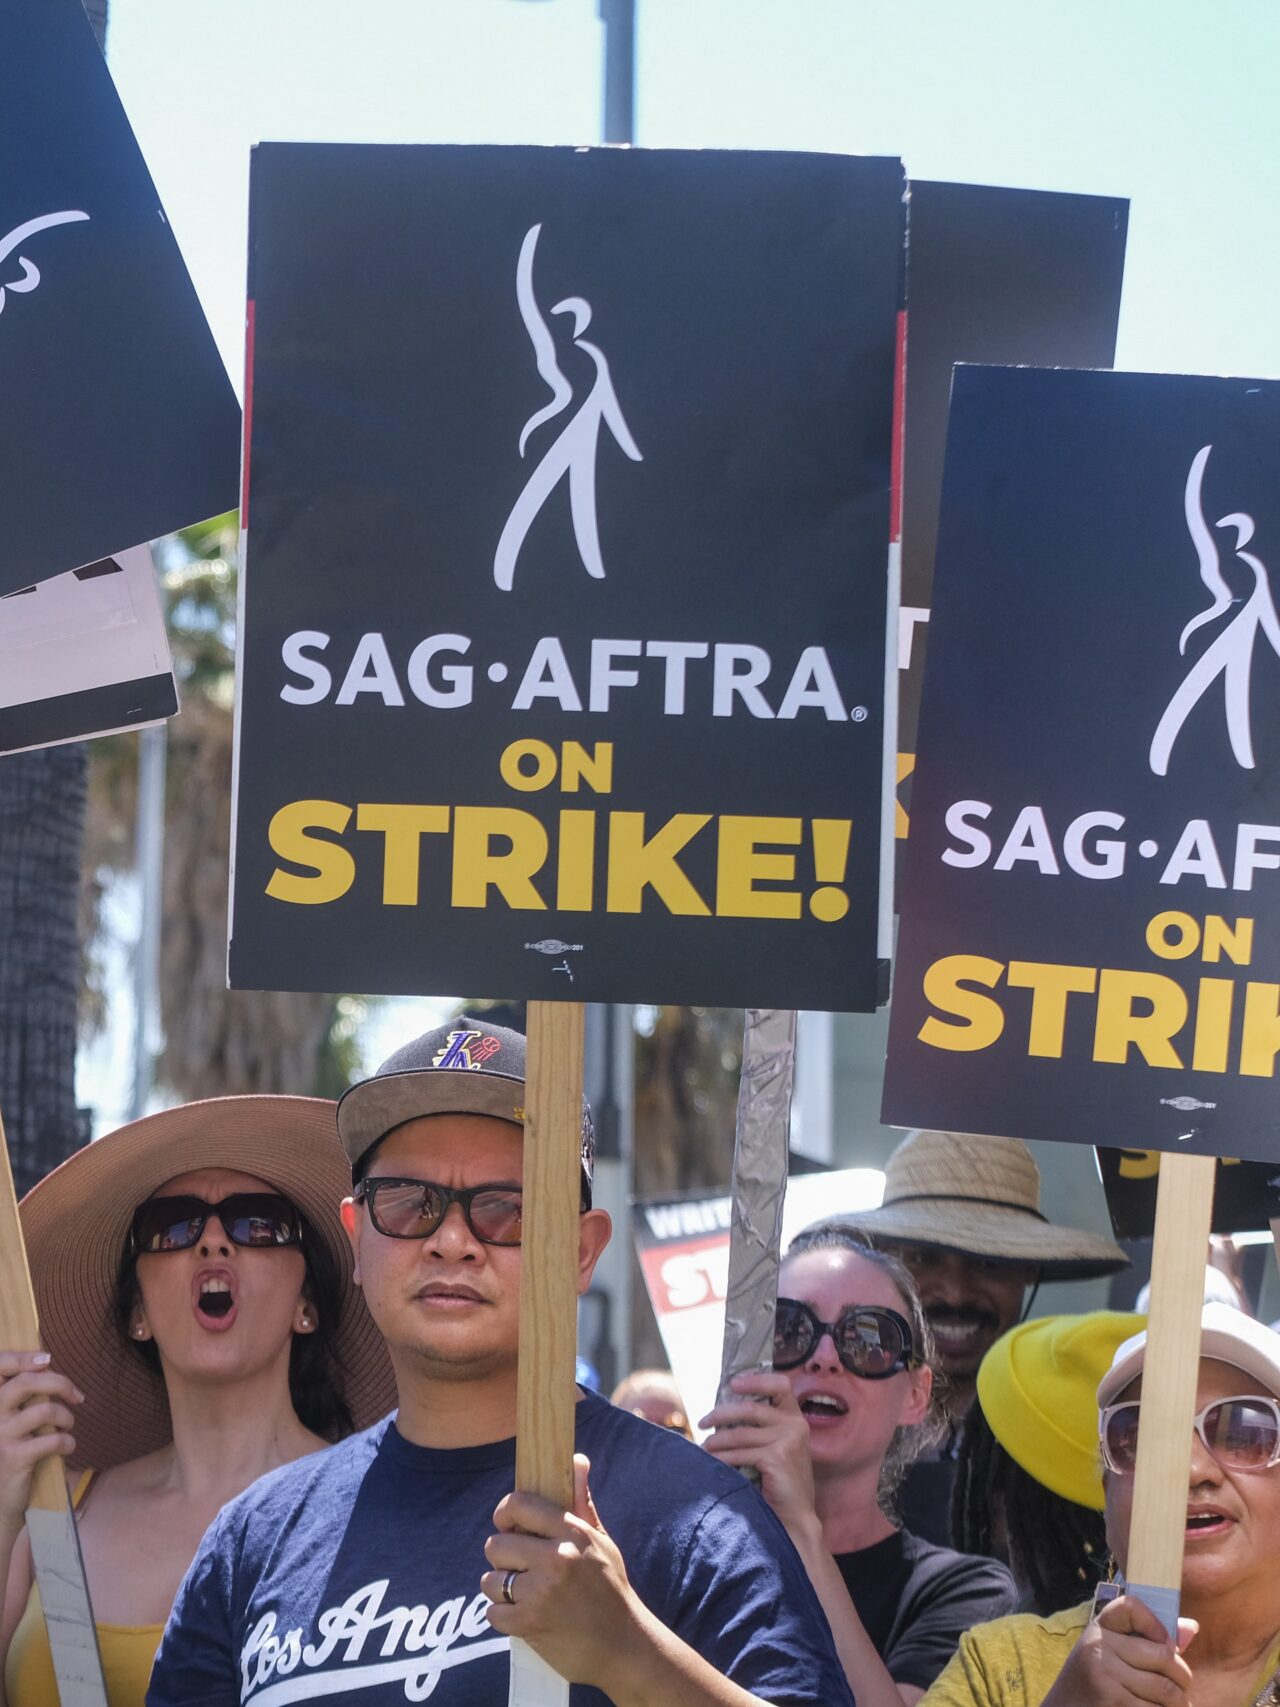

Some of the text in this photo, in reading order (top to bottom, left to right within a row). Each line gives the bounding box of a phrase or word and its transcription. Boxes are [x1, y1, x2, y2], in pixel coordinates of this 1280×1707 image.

[499, 739, 614, 794] ON
[265, 799, 853, 922] STRIKE!
[940, 800, 1280, 892] SAG·AF
[1145, 911, 1255, 966] ON
[240, 1578, 496, 1705] Los Ange
